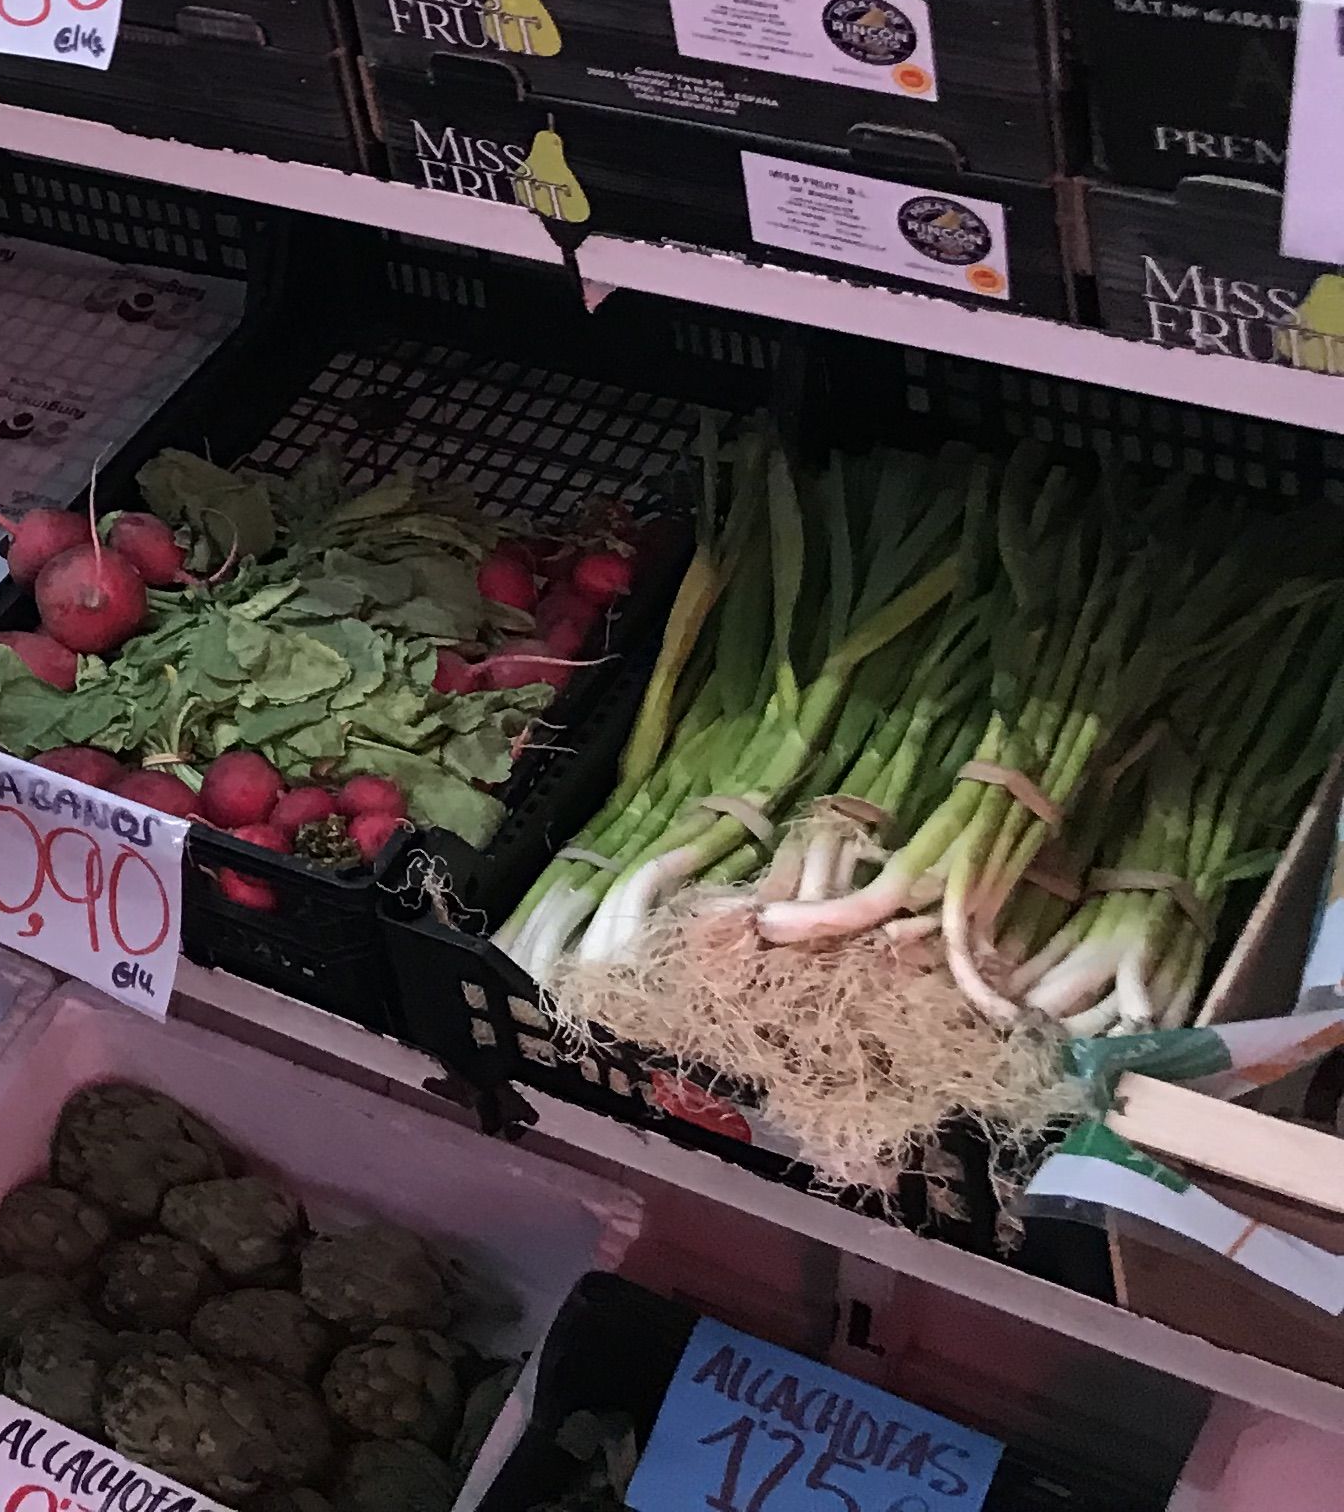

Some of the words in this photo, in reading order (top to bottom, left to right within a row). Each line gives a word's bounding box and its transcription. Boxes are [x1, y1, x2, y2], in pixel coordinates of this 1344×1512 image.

[410, 118, 533, 178] MISS
[1141, 255, 1302, 328] MISS
[691, 1343, 972, 1497] ALCACHOFAS
